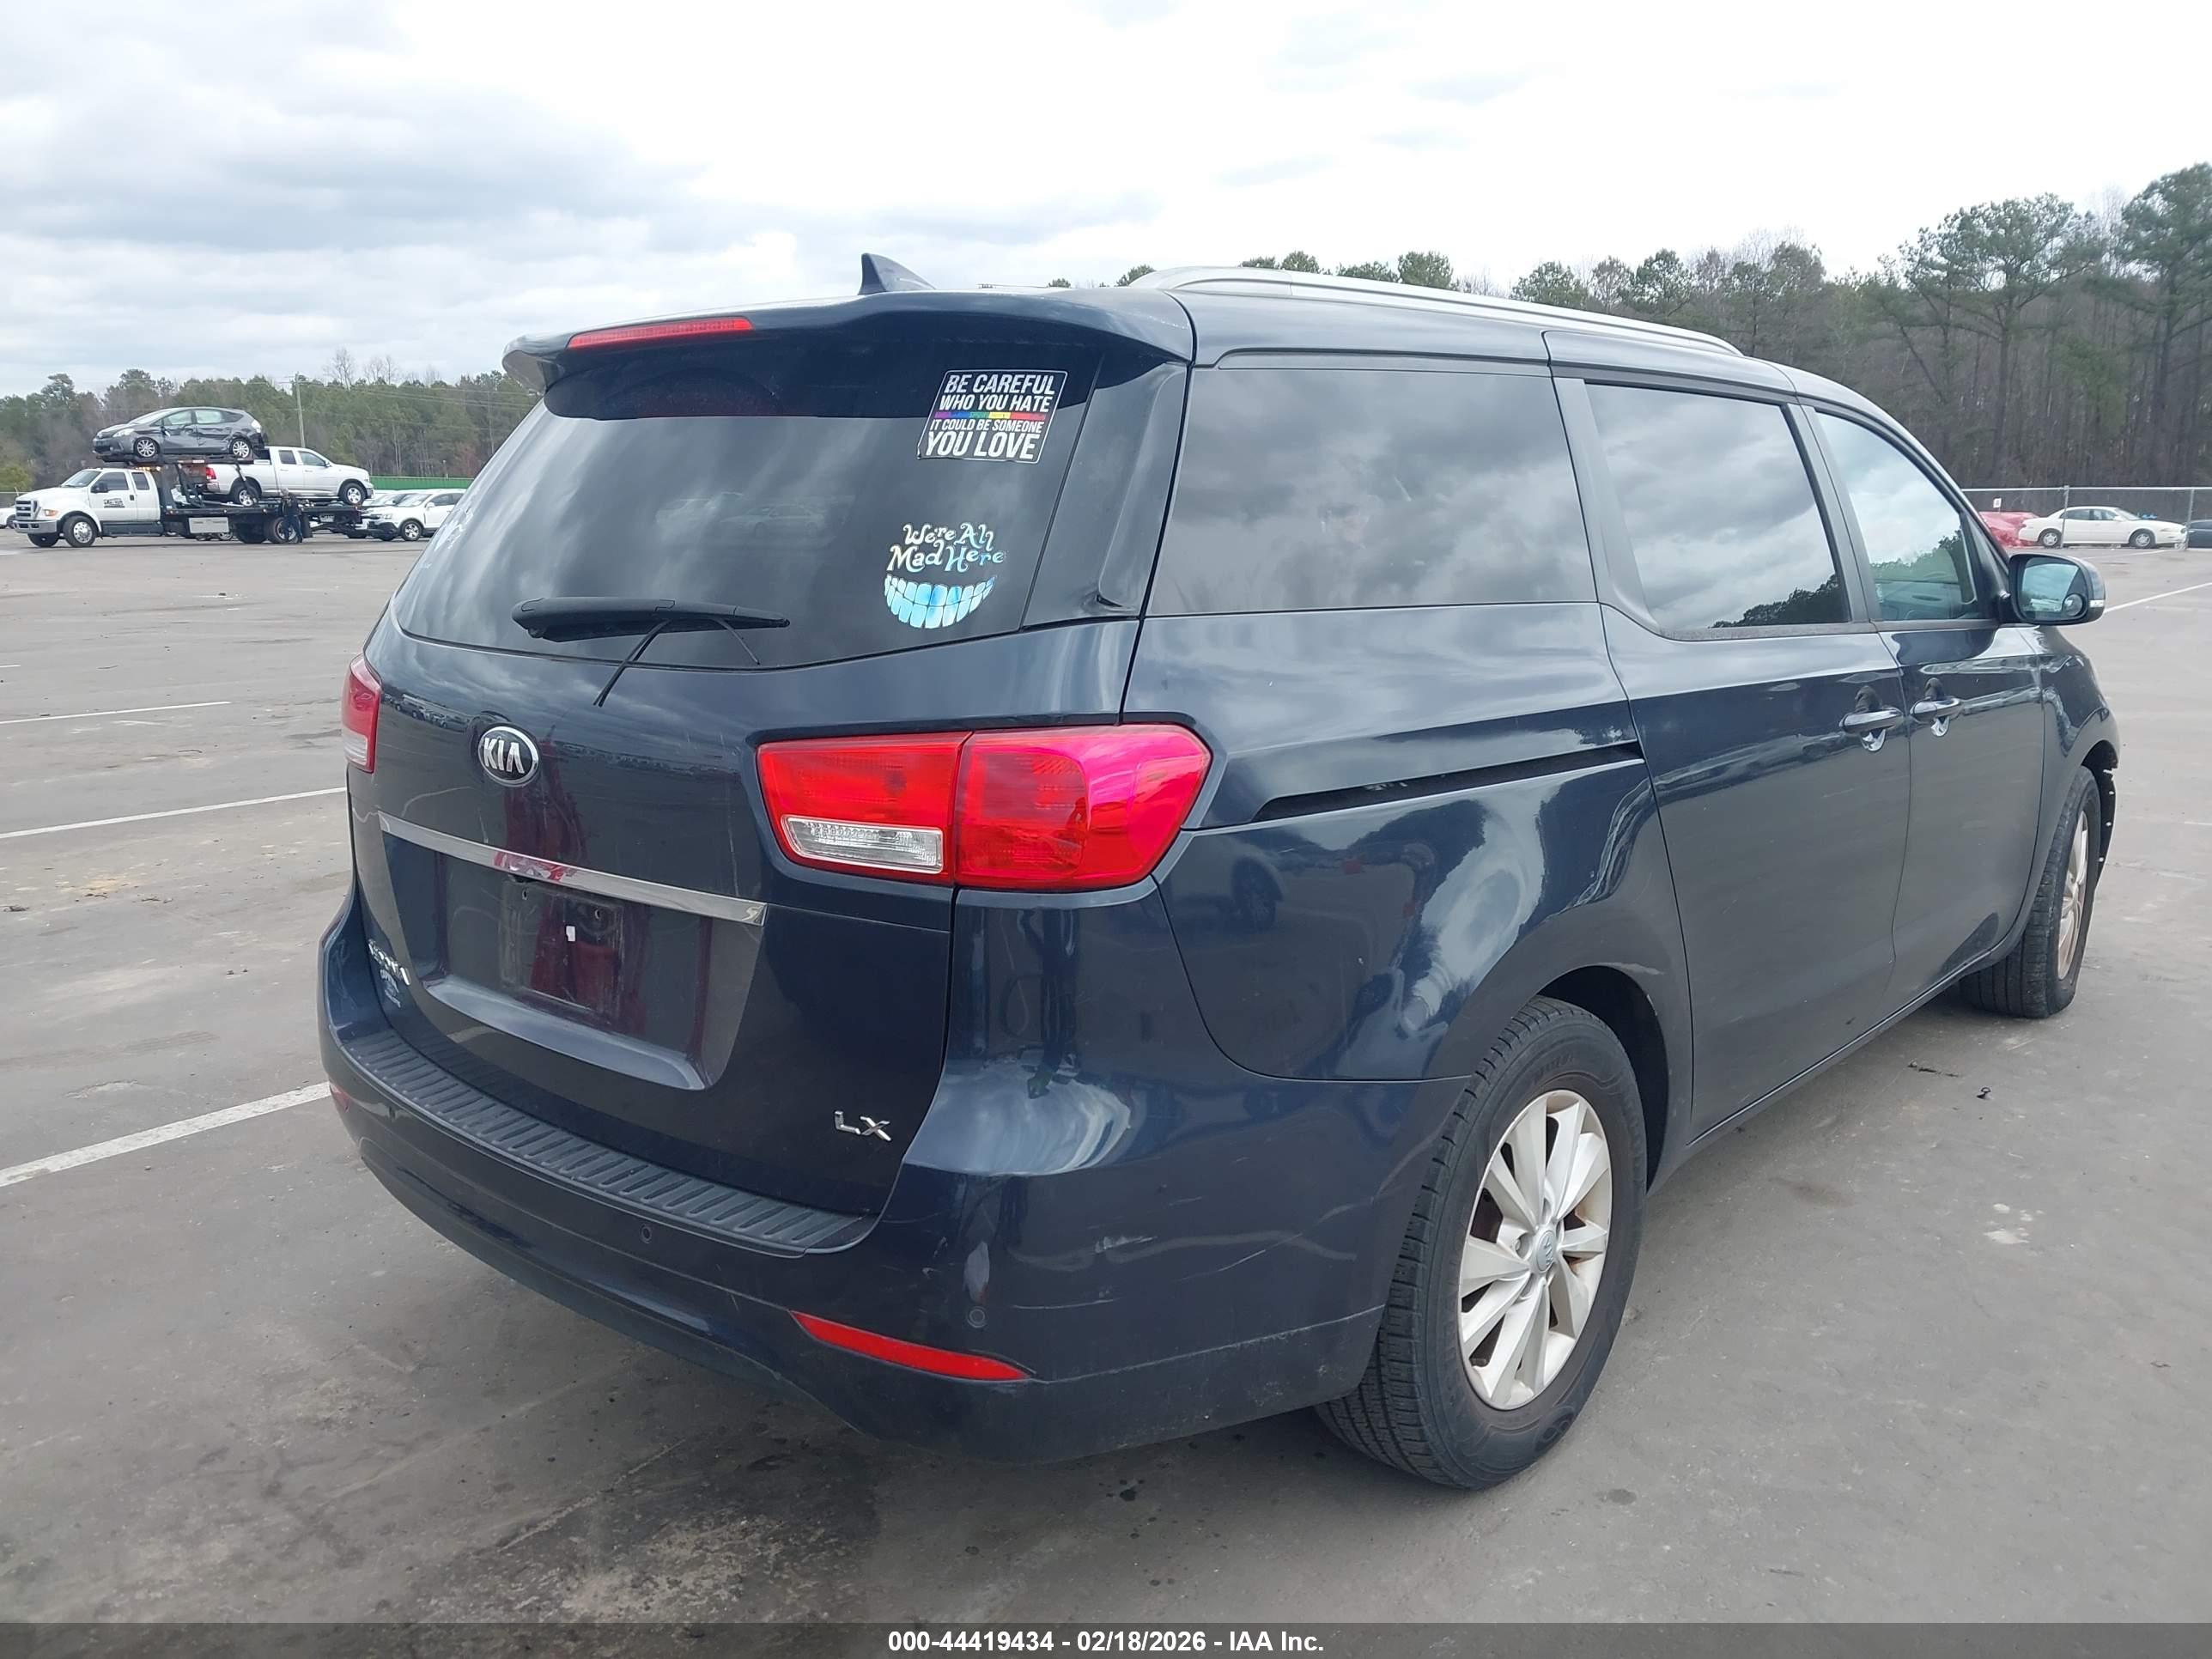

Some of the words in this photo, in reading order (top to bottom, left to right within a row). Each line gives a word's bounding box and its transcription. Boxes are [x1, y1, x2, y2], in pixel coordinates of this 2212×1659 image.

[944, 374, 972, 393] BE
[973, 374, 1055, 395] CAREFUL
[939, 394, 975, 410] WHO
[978, 395, 1006, 411] YOU
[1010, 395, 1053, 412] HATE
[930, 419, 942, 429] IT
[942, 419, 974, 431] COULD
[975, 420, 991, 431] BE
[992, 420, 1044, 434] SOMEONE
[926, 431, 973, 456] YOU
[973, 432, 1040, 459] LOVE
[902, 523, 956, 545] We're
[954, 522, 994, 551] All
[886, 539, 944, 573] Mad
[945, 546, 1004, 573] Here
[483, 737, 526, 774] KIA
[834, 1110, 891, 1141] LX
